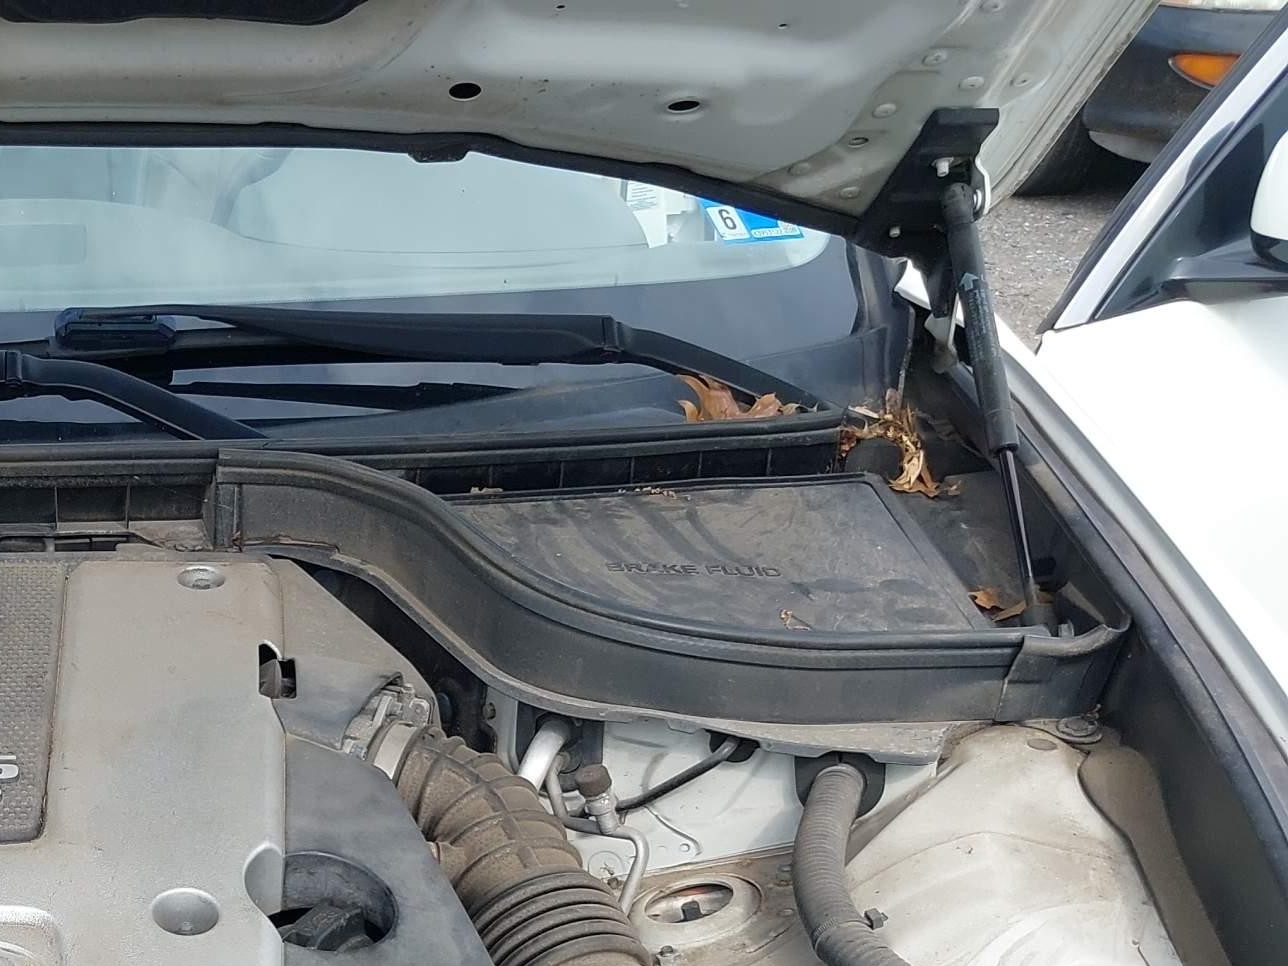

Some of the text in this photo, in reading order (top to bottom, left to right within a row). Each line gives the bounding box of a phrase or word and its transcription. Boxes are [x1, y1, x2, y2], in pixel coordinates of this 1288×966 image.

[718, 208, 737, 230] 6
[605, 561, 782, 578] BRAKE FLUID
